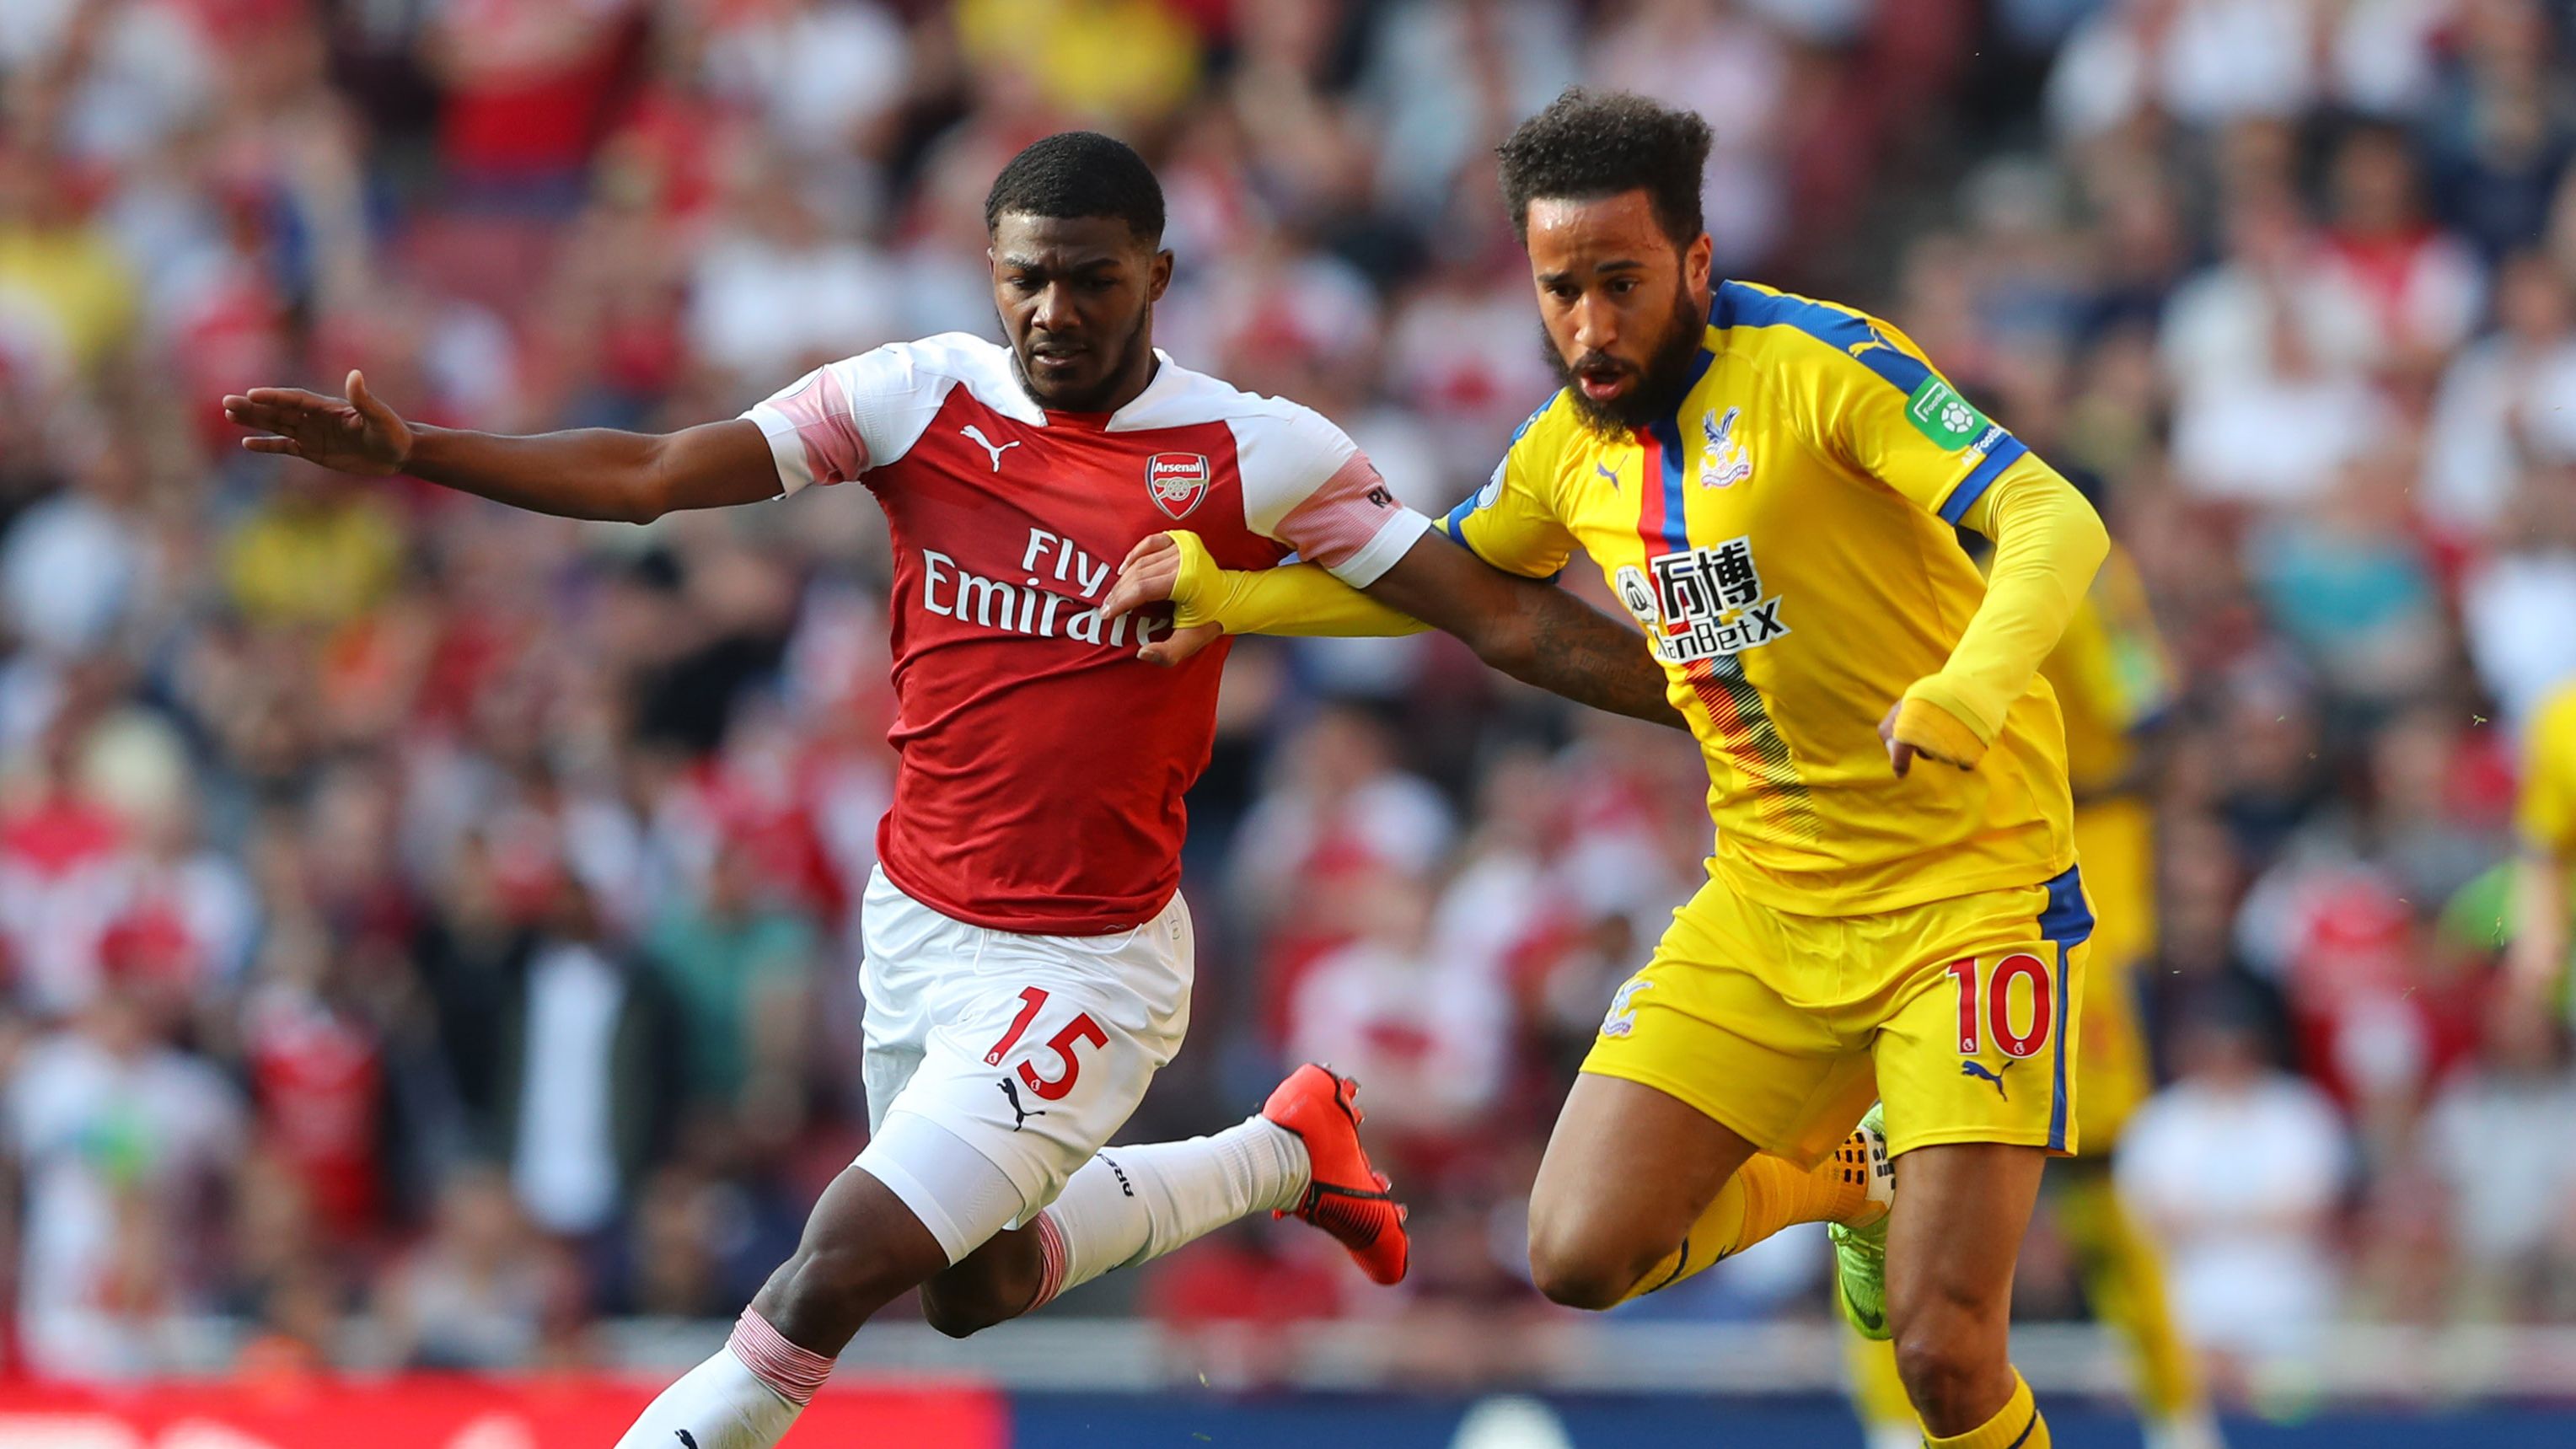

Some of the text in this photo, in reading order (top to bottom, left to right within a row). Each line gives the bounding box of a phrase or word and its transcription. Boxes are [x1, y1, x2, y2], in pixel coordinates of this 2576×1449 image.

[1154, 462, 1200, 473] Arsenal
[923, 549, 1170, 648] Emirate
[1022, 528, 1111, 599] Fly
[983, 985, 1110, 1101] 15
[1945, 953, 2052, 1059] 10
